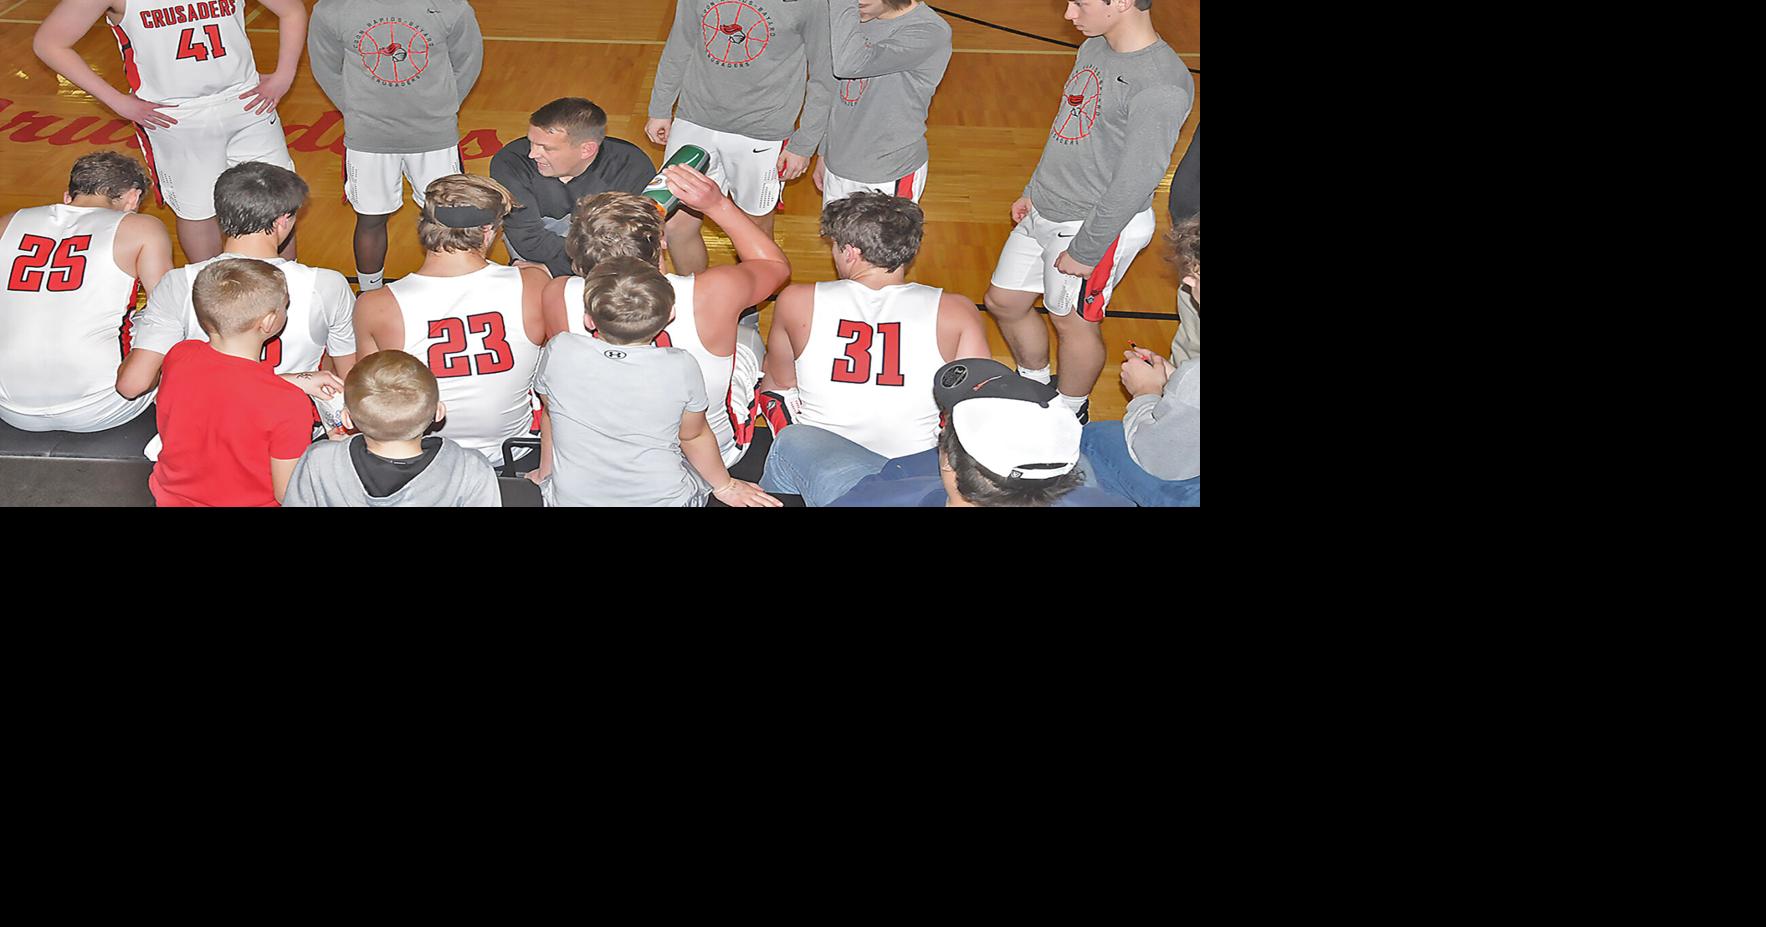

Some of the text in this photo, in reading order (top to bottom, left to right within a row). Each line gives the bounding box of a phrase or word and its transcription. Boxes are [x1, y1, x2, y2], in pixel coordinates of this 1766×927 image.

[140, 0, 236, 28] CRUSADERS
[176, 24, 227, 61] 41
[7, 233, 92, 292] 25
[427, 311, 515, 378] 23
[830, 318, 905, 387] 31
